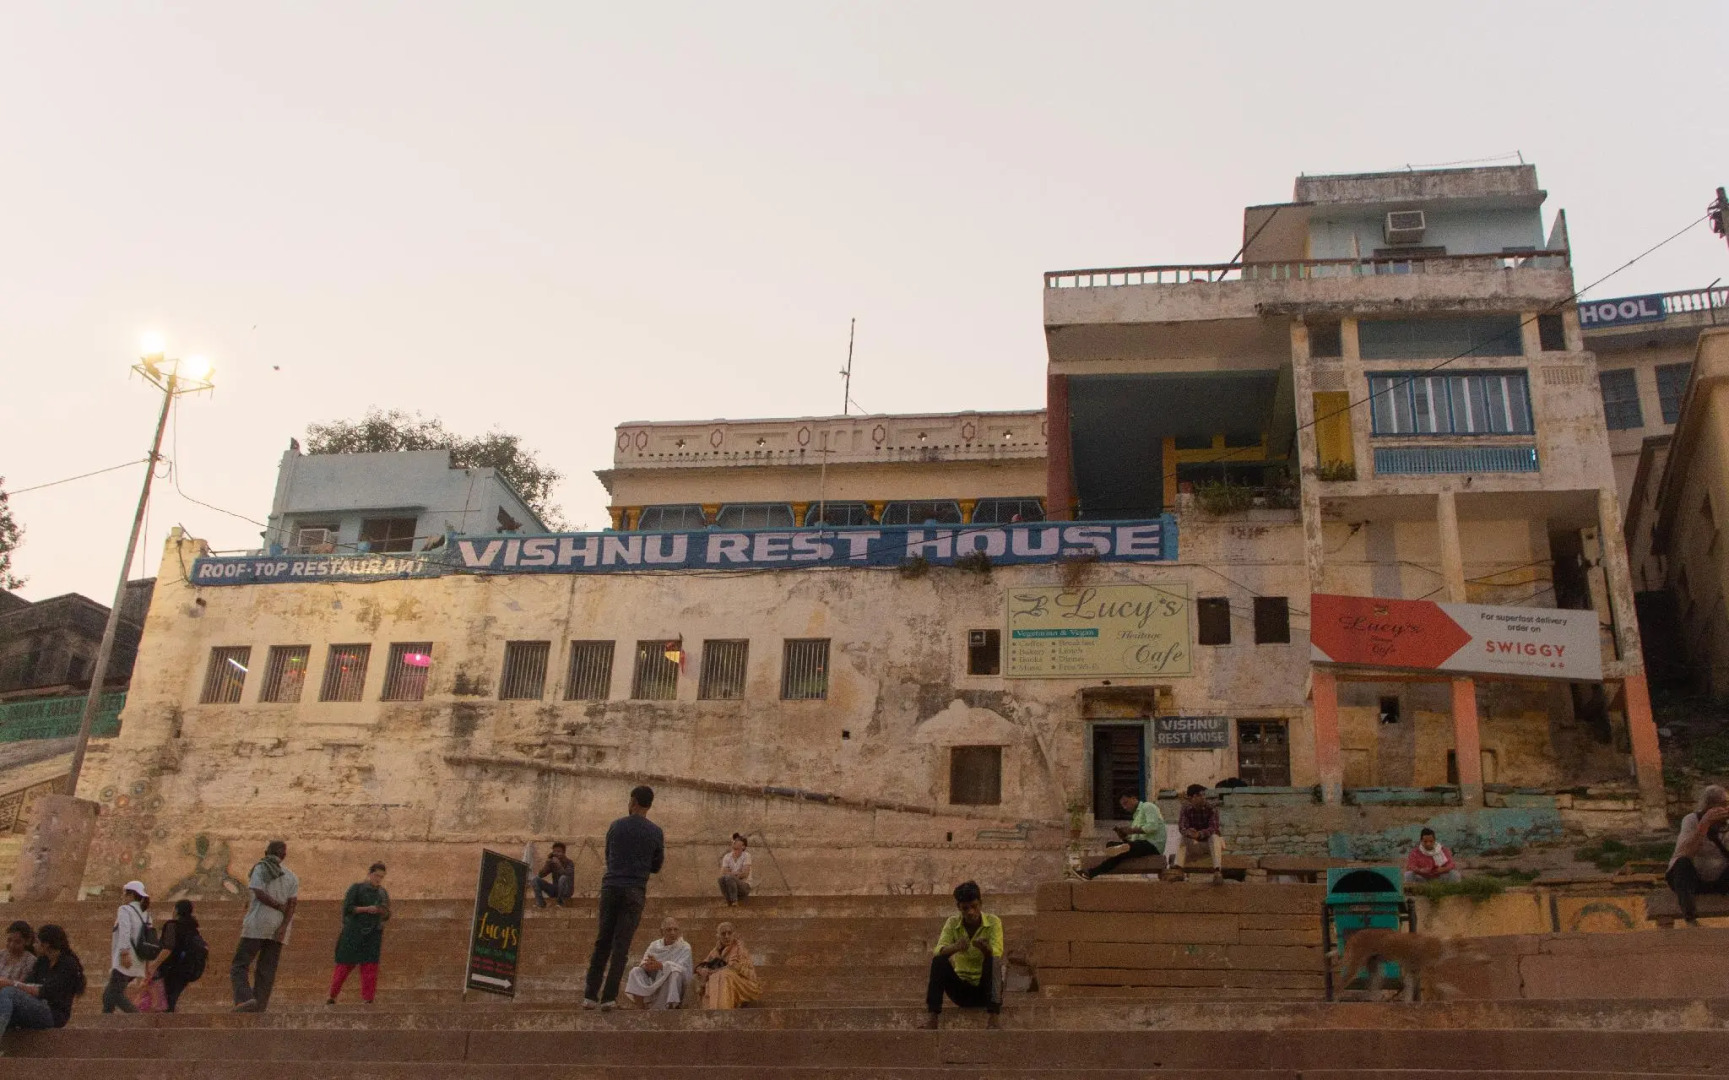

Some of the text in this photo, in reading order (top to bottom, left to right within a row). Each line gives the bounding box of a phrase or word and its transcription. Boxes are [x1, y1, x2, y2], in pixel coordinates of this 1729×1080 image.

[457, 524, 1161, 567] VISHNU REST HOUSE
[1054, 587, 1184, 629] Lucy's
[1480, 612, 1568, 626] For superfast delivery
[1016, 630, 1058, 638] Vegetarian
[1070, 629, 1095, 637] Vegan
[1507, 624, 1529, 632] order
[1485, 640, 1566, 657] SWIGGY
[1130, 642, 1184, 671] Cafe
[1161, 719, 1218, 731] VISHNU
[1157, 731, 1225, 744] REST HOUSE
